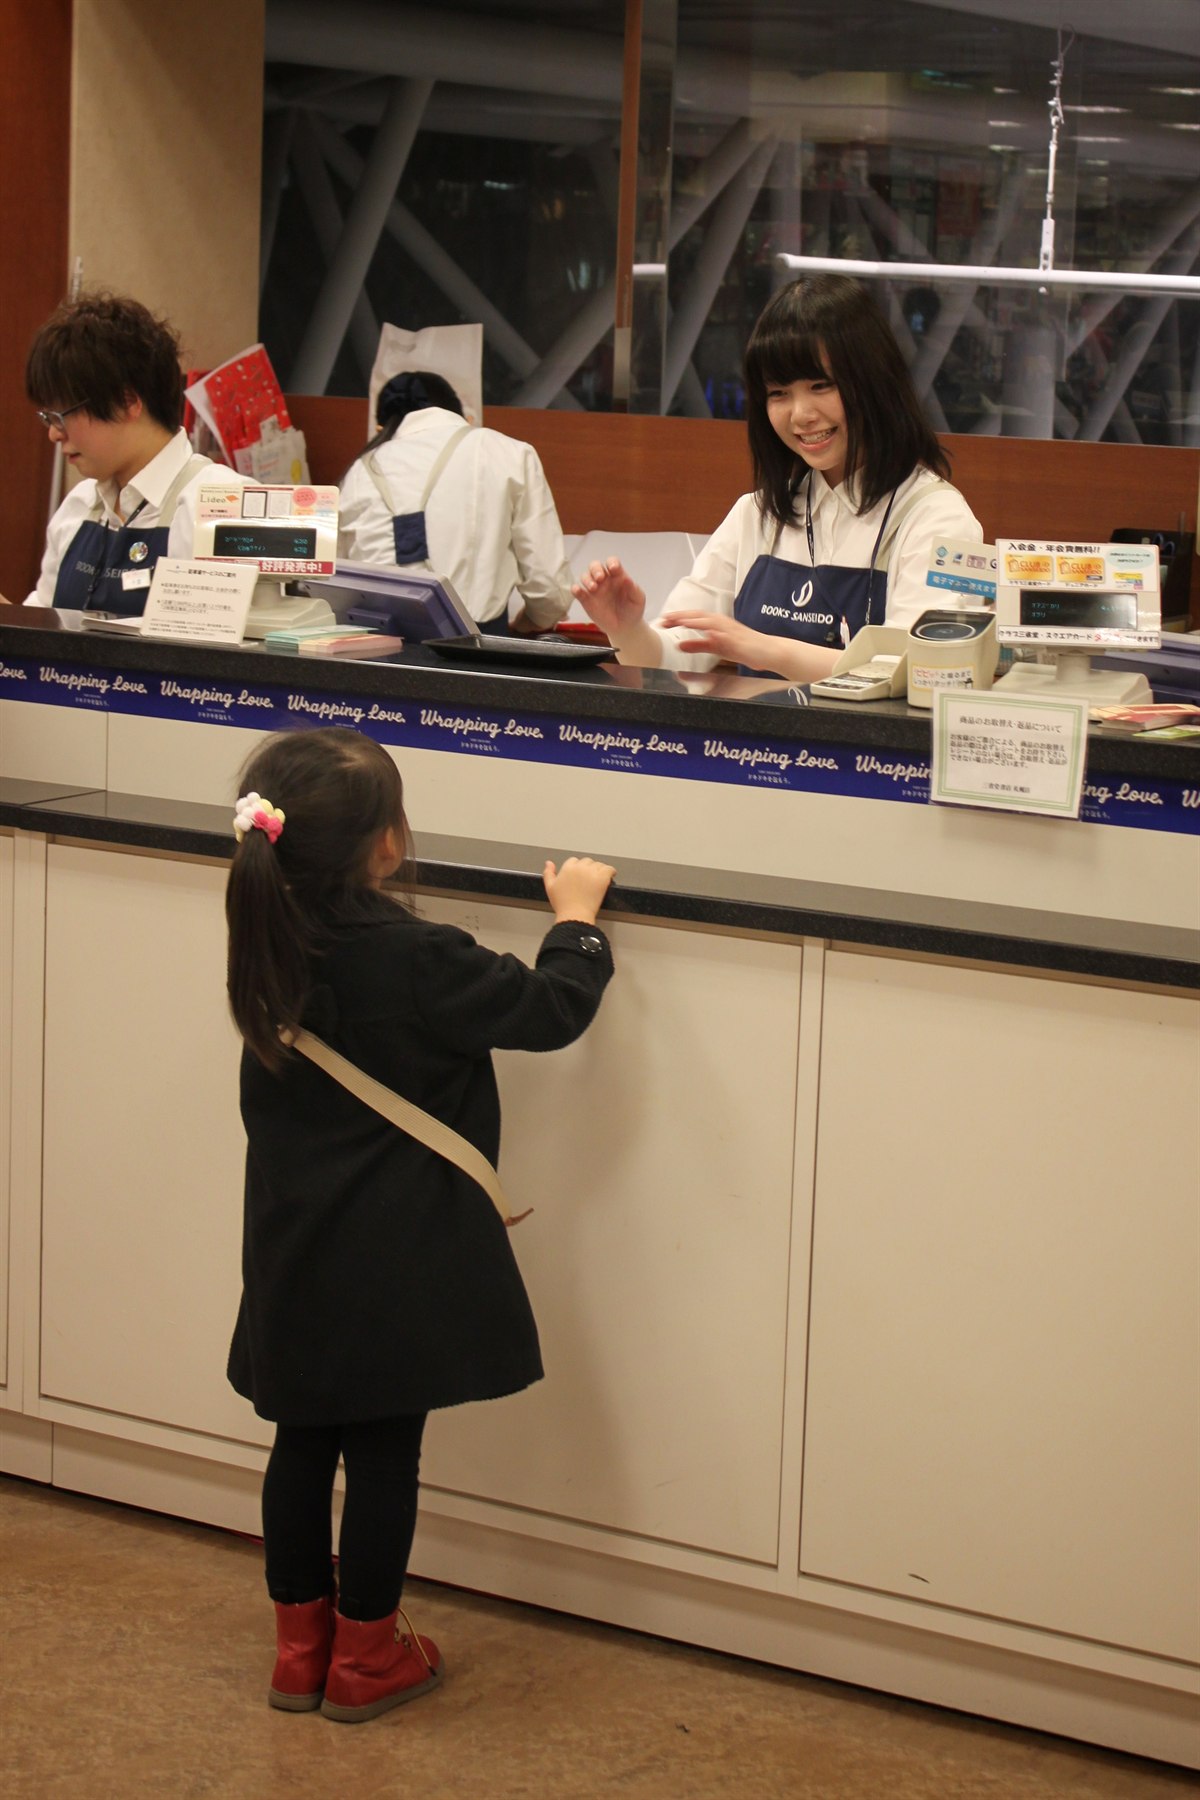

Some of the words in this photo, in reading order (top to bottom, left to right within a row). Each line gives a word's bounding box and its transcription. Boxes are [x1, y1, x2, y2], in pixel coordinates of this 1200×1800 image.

[200, 494, 226, 503] Lideo
[261, 561, 322, 572] 好評発売中!
[761, 604, 790, 618] BOOKS
[791, 612, 834, 625] SANSEIDO
[39, 666, 110, 694] Wrapping
[112, 675, 148, 694] Love.
[160, 680, 235, 708] Wrapping
[237, 689, 274, 708] Love.
[287, 694, 366, 723] Wrapping
[367, 704, 406, 723] Love.
[420, 709, 502, 739] Wrapping
[504, 719, 544, 739] Love.
[959, 715, 1063, 733] 商品のお取替え・返品について
[558, 724, 644, 754] Wrapping
[646, 734, 688, 755] Love.
[703, 740, 793, 770] Wrapping
[795, 749, 839, 770] Love.
[855, 754, 932, 783] Wrappin
[1115, 782, 1164, 805] Love.
